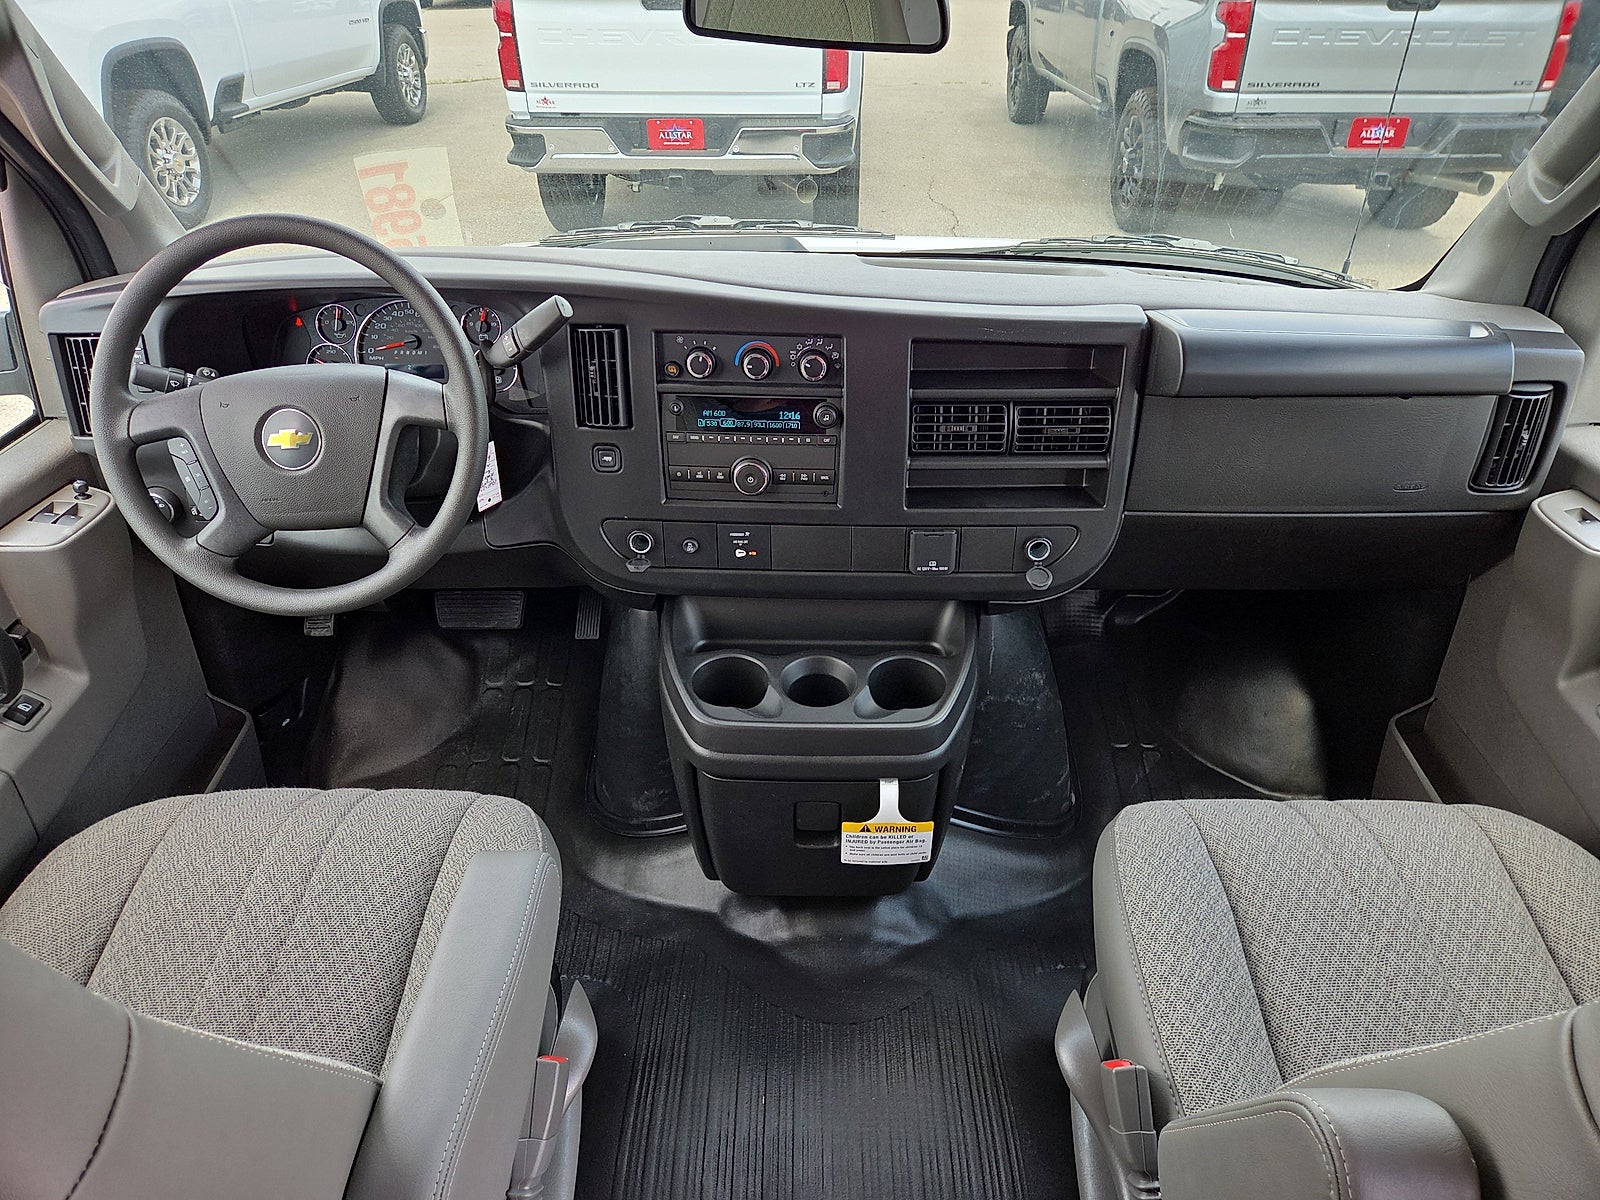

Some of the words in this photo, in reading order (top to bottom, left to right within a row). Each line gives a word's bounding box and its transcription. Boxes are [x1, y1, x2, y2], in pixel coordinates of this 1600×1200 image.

[1271, 29, 1537, 46] CHEVROLET
[659, 131, 693, 139] ALLSTAR
[391, 310, 404, 318] 40
[374, 322, 387, 330] 20
[779, 411, 800, 420] 12:16
[874, 825, 917, 833] WARNING
